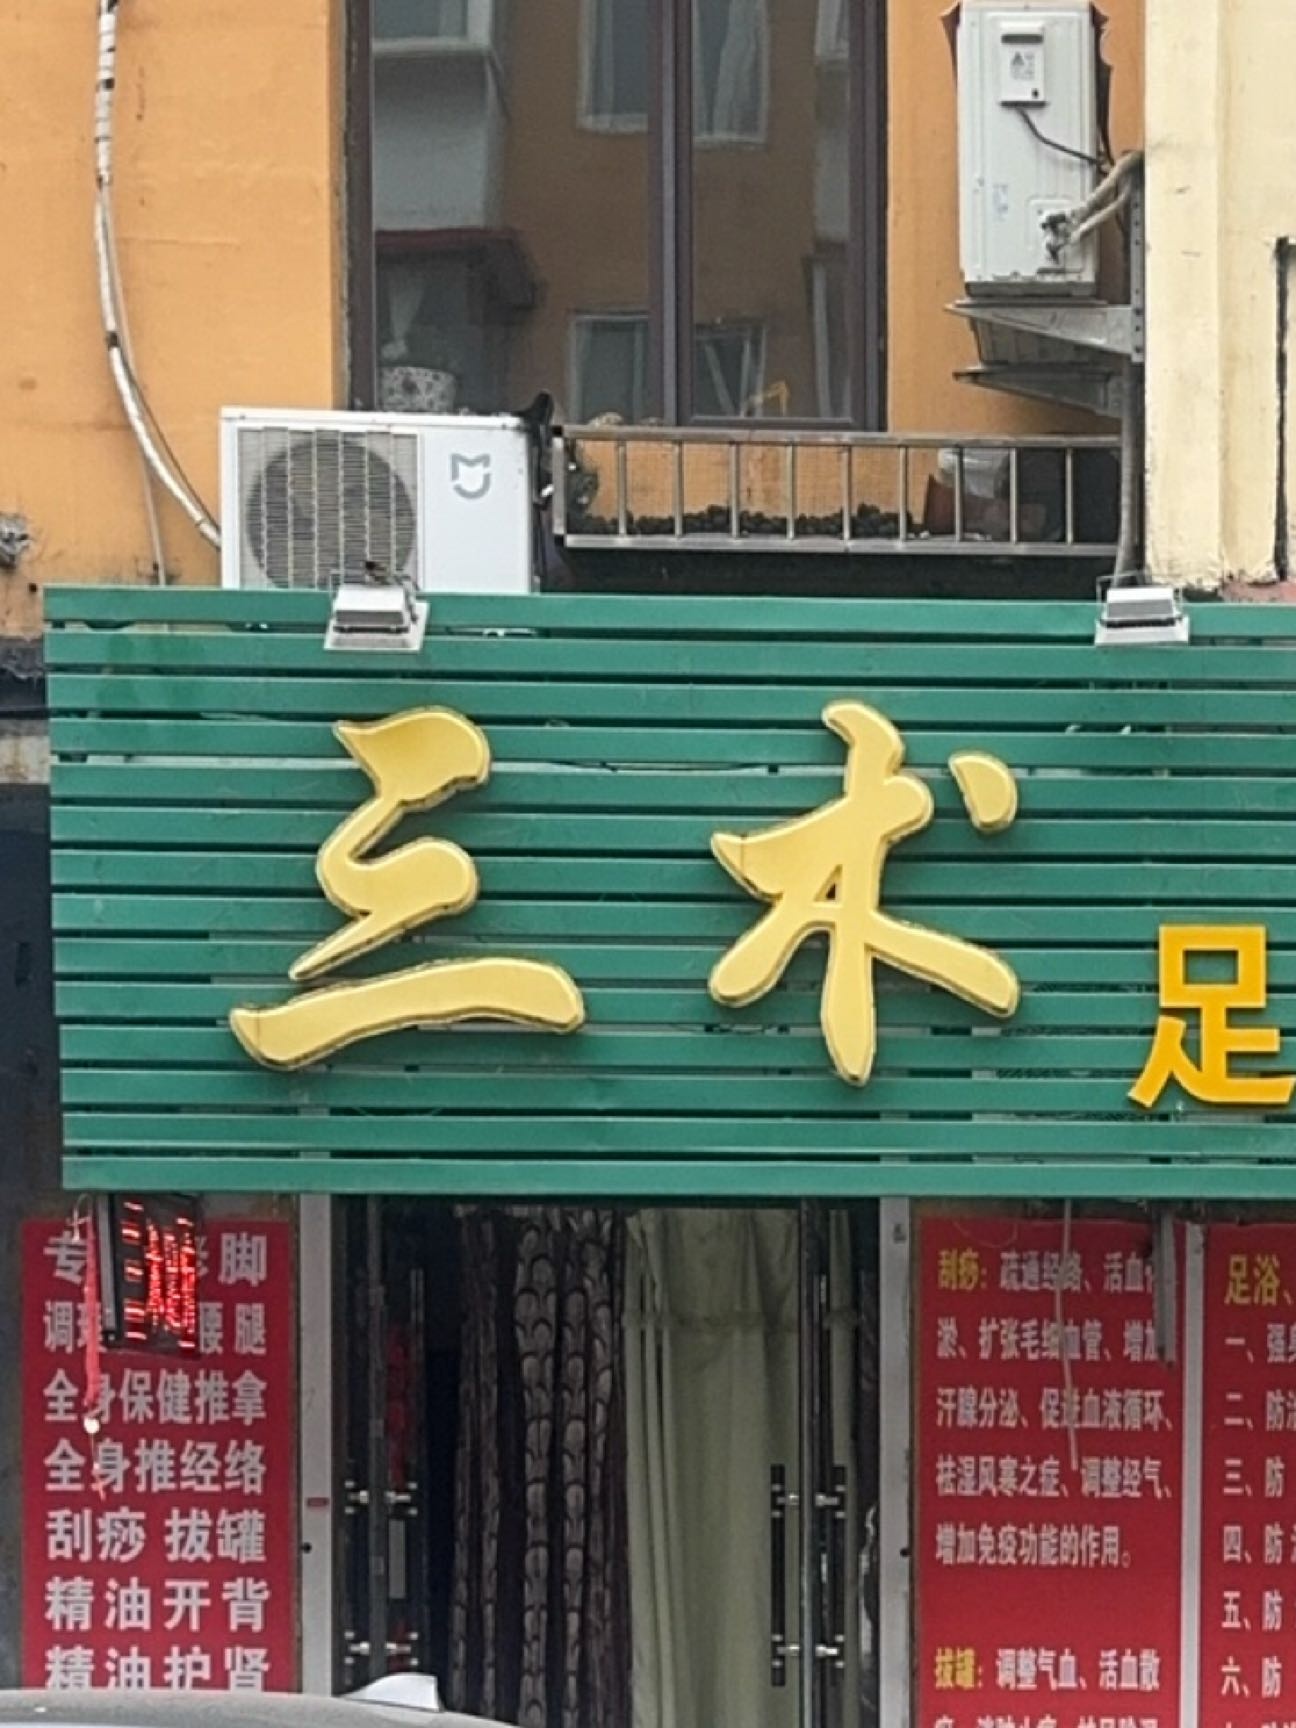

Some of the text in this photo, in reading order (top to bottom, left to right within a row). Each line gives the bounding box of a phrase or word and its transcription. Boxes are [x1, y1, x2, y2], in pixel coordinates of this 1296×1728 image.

[44, 1438, 267, 1493] 全身推经络
[45, 1576, 270, 1632] 精油开背
[45, 1645, 270, 1691] 精油护肾
